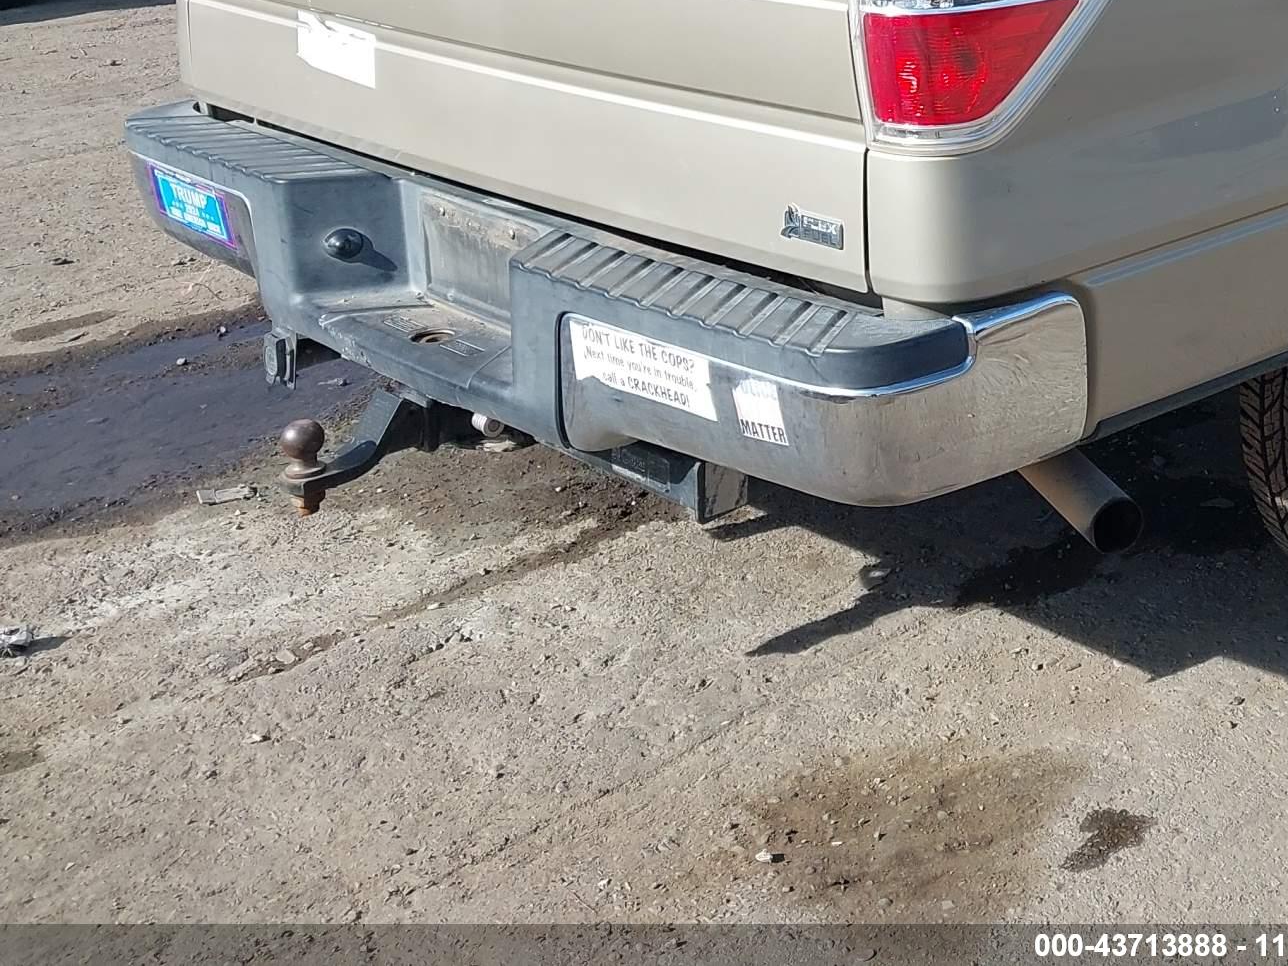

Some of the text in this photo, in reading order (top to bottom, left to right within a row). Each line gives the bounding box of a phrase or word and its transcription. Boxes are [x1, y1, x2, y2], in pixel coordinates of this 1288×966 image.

[803, 216, 837, 235] FLEX
[582, 323, 695, 374] DON'T LIKE THE COPS?
[607, 353, 625, 367] time
[627, 359, 651, 375] you're
[654, 366, 662, 378] in
[602, 372, 690, 407] call a CRACKHEAD!
[740, 418, 787, 444] MATTER
